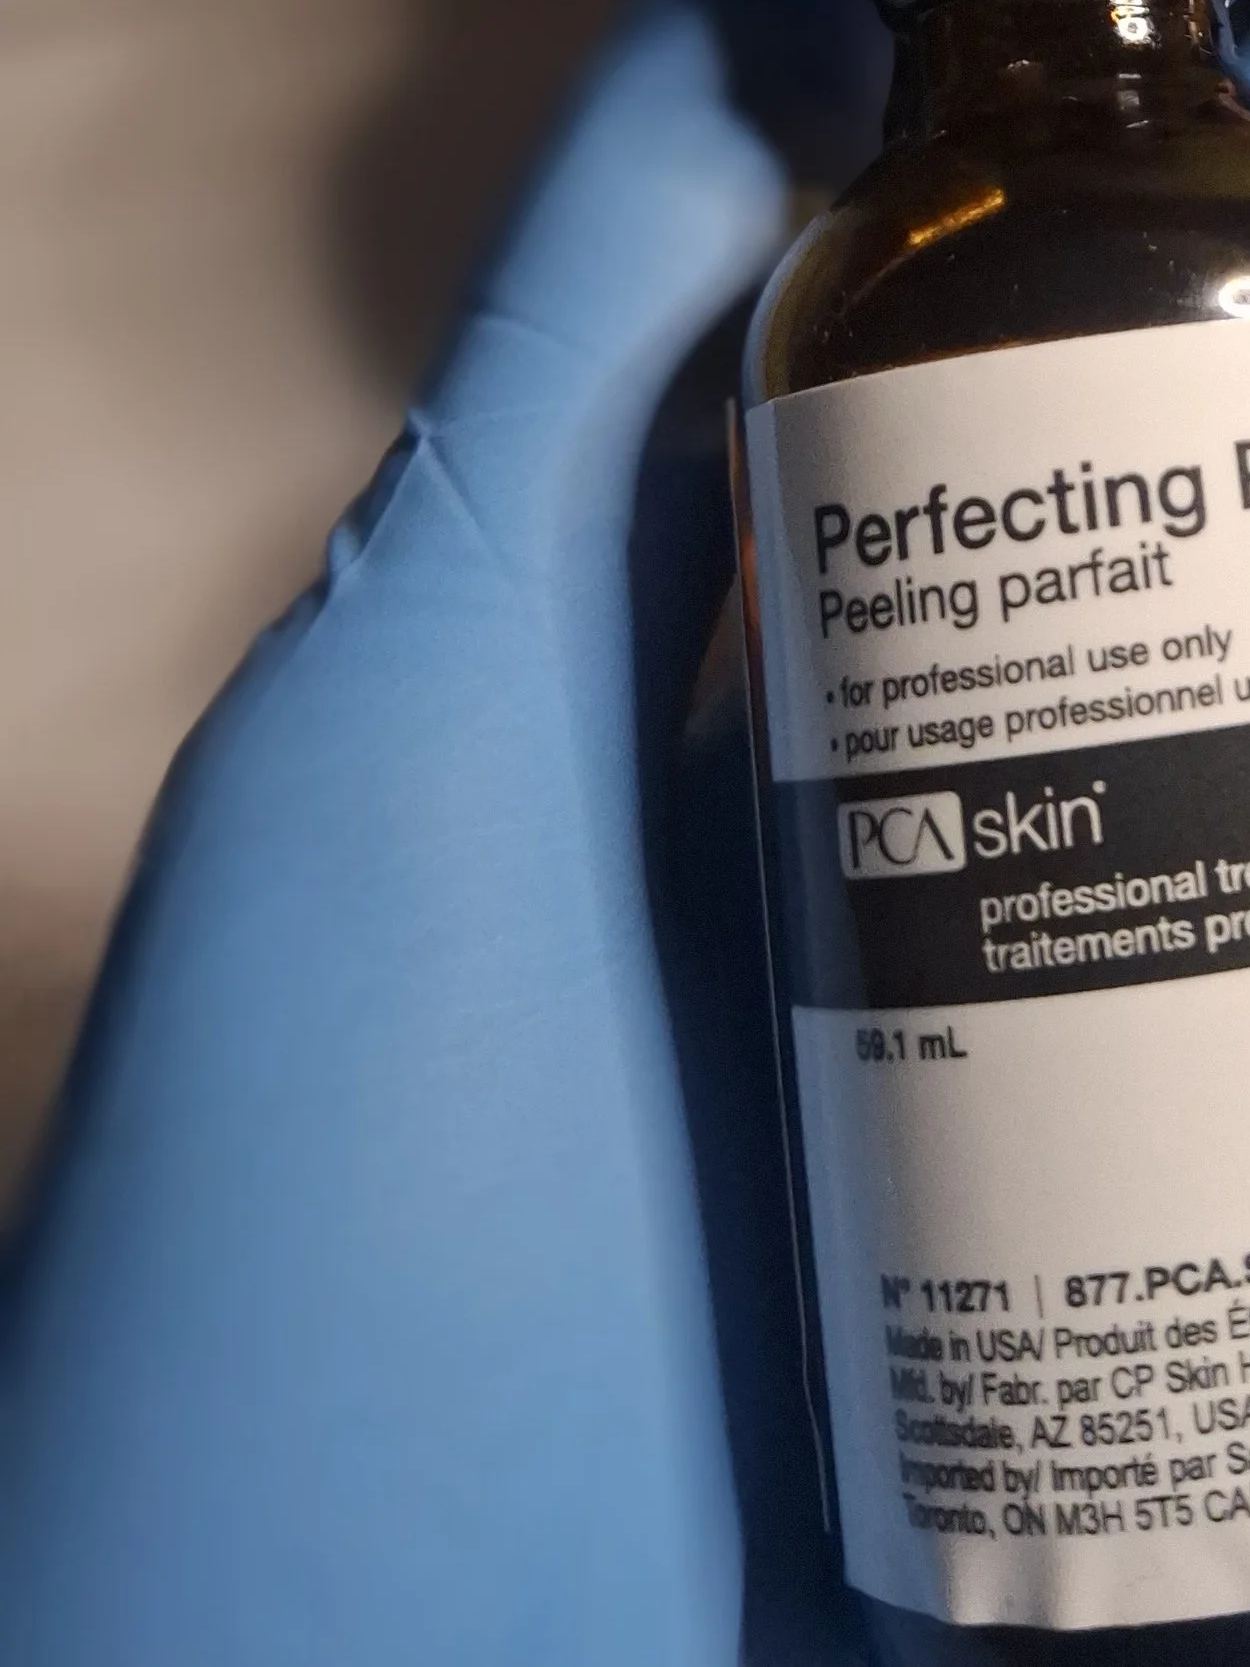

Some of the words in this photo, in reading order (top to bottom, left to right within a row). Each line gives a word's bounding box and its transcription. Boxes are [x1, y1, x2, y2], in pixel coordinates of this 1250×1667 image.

[813, 460, 1209, 574] Perfecting
[819, 577, 979, 640] Peeling
[999, 541, 1174, 624] parfait
[839, 675, 873, 708] for
[882, 644, 1076, 710] professional
[1087, 638, 1149, 671] use
[1162, 622, 1234, 664] only
[844, 725, 899, 764] pour
[907, 710, 995, 752] usage
[1005, 675, 1225, 743] professionnel
[847, 806, 955, 869] PCA
[980, 860, 1209, 933] professional
[981, 915, 1197, 974] traitements
[918, 1025, 969, 1060] mL
[921, 1277, 1011, 1313] 11271
[949, 1329, 972, 1363] in
[1054, 1321, 1160, 1362] Produit
[1165, 1315, 1219, 1349] des
[980, 1370, 1049, 1407] Fabr.
[1055, 1375, 1103, 1413] par
[1111, 1364, 1155, 1402] CP
[1165, 1353, 1231, 1396] Skin
[1029, 1414, 1073, 1449] AZ
[1080, 1407, 1184, 1447] 85251,
[1050, 1451, 1158, 1499] Importé
[1169, 1452, 1217, 1491] par
[1001, 1499, 1047, 1536] ON
[1054, 1498, 1127, 1535] M3H
[1134, 1492, 1194, 1532] 5T5
